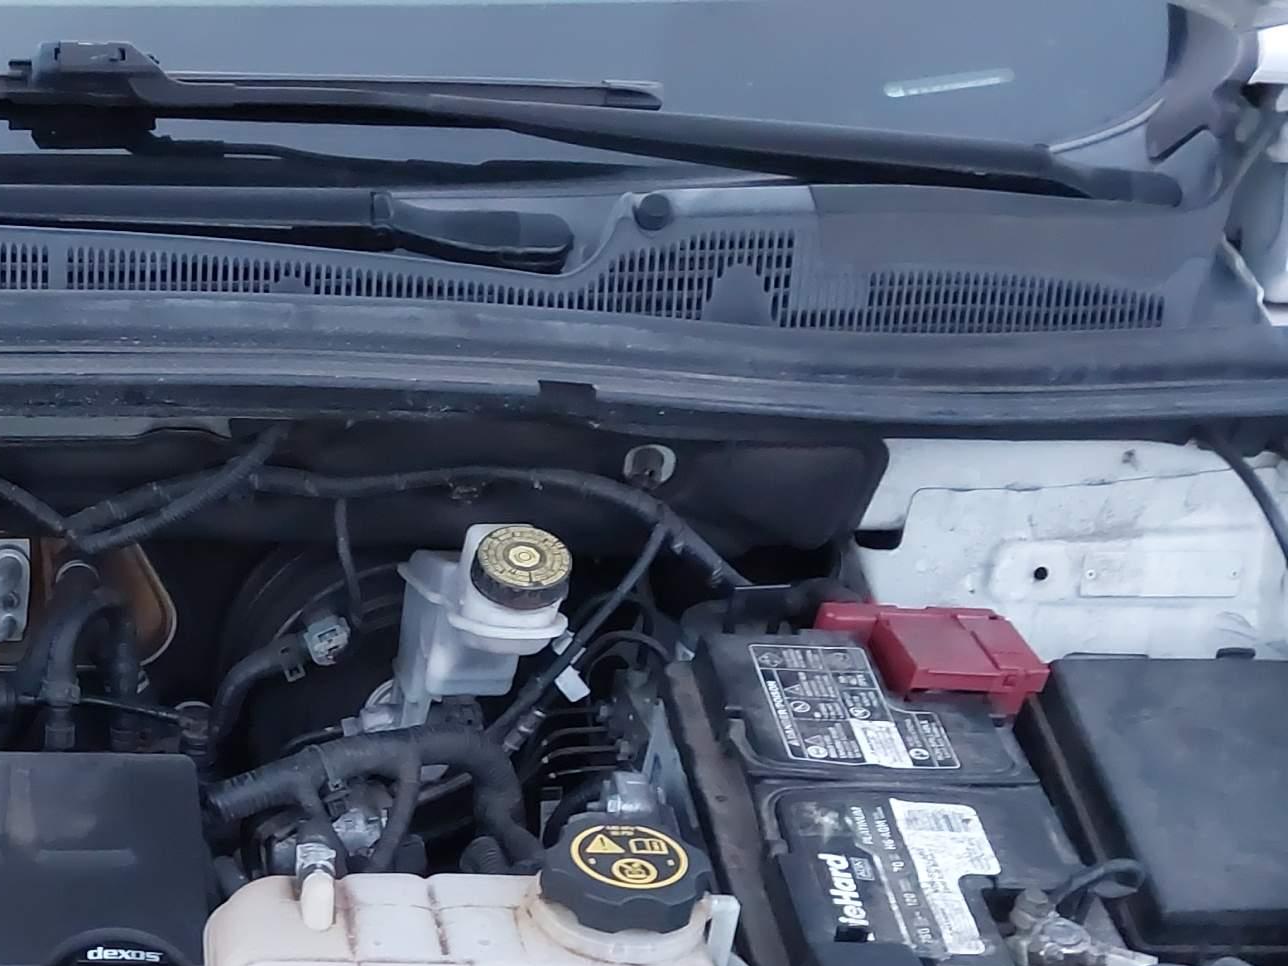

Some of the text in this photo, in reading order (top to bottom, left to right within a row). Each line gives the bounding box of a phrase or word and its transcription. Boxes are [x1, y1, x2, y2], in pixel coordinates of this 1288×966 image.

[850, 805, 874, 846] PLATINUM
[817, 852, 875, 942] ieHard
[86, 946, 164, 963] dexos
